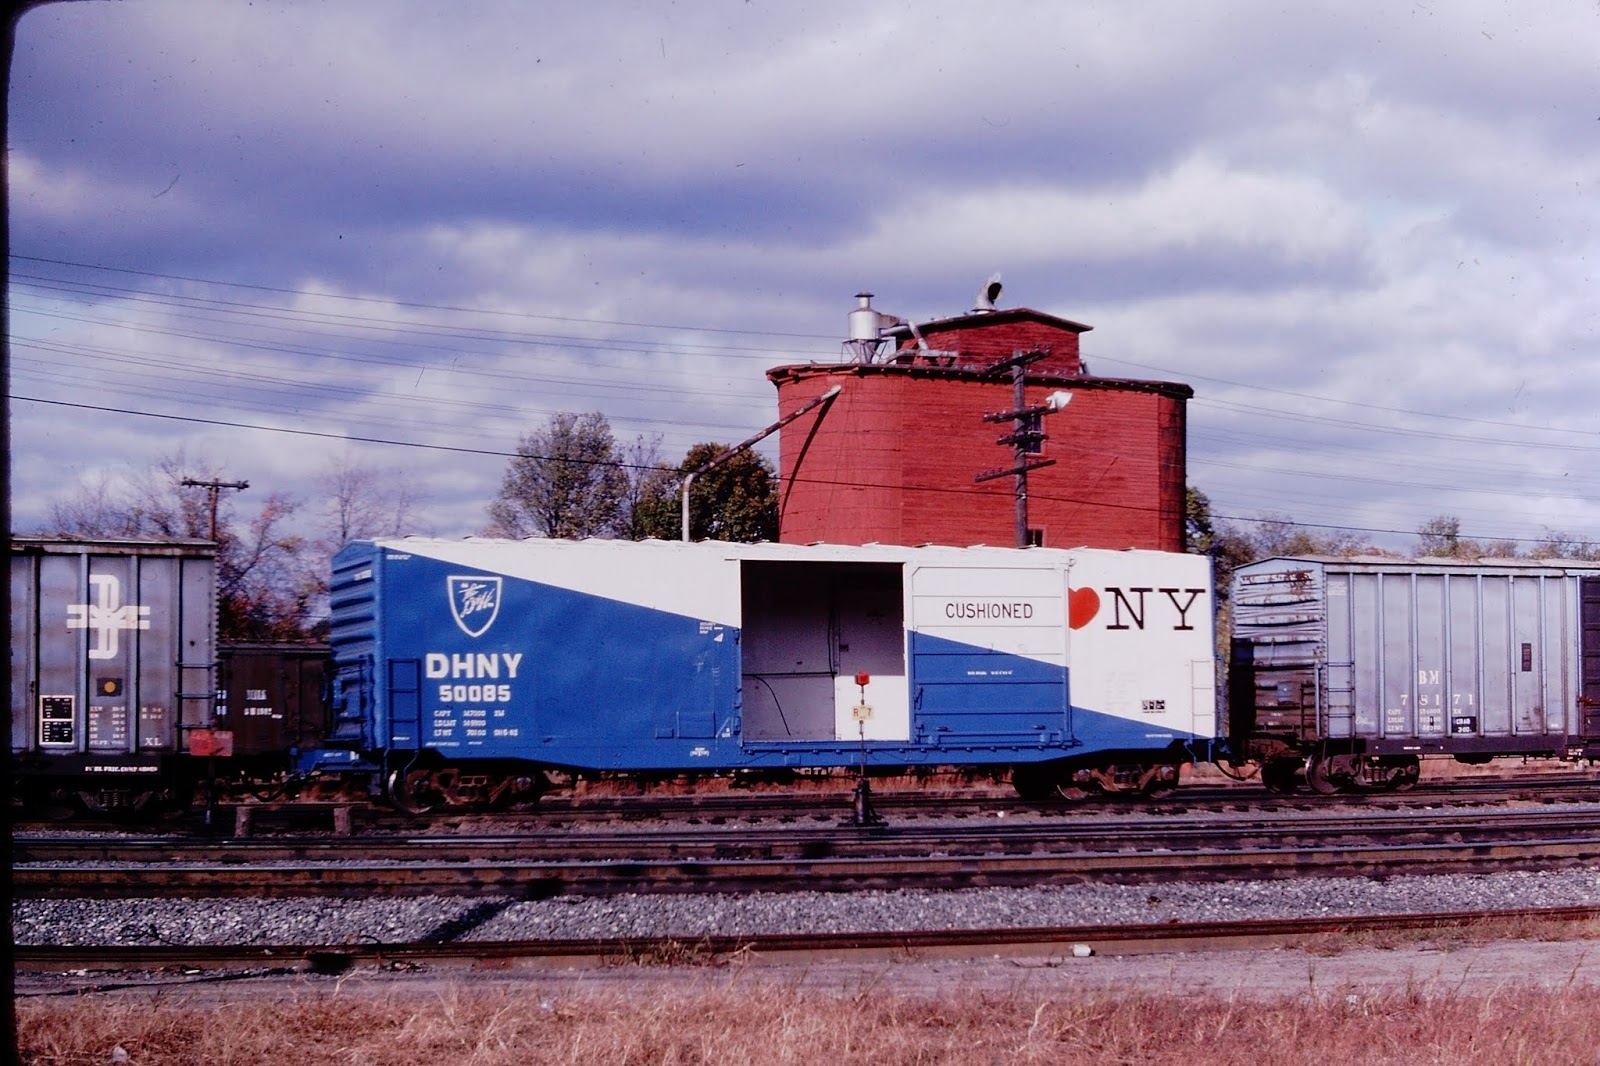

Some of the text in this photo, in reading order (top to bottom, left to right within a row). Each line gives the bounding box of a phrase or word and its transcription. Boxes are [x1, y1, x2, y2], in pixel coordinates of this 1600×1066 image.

[945, 603, 1033, 619] CUSHIONED
[1105, 587, 1206, 630] NY
[425, 653, 523, 679] DHNY
[1418, 670, 1440, 685] BM
[439, 684, 511, 702] 50085
[144, 737, 162, 746] XL
